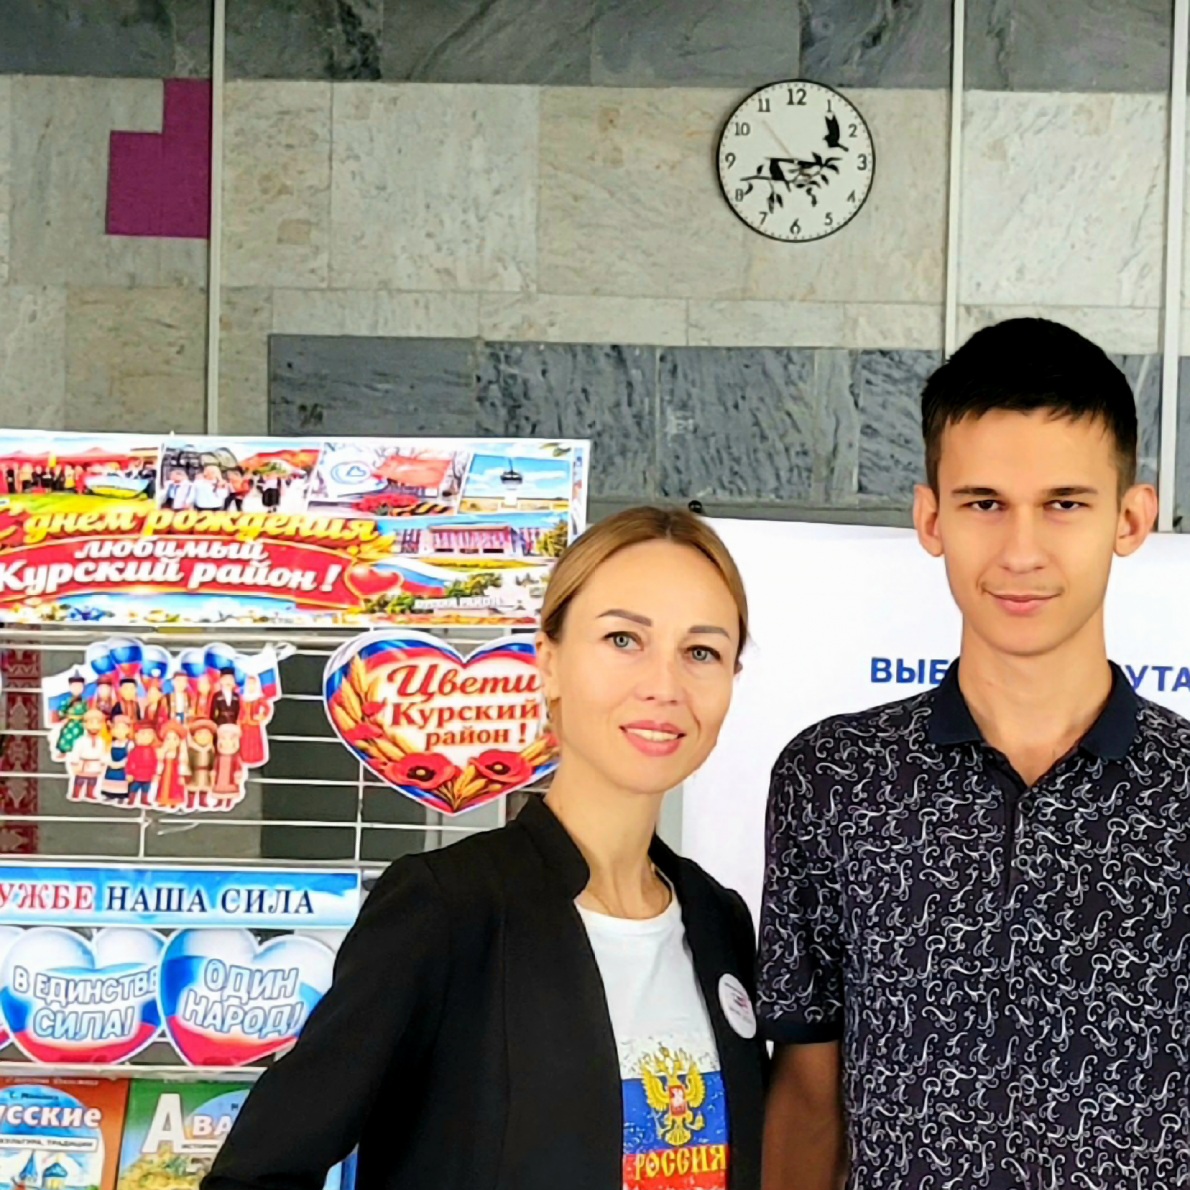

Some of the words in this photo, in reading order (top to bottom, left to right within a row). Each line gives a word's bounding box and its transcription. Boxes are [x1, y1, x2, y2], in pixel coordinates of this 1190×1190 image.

[758, 98, 771, 113] 11
[787, 88, 807, 106] 12
[826, 100, 833, 113] 1
[735, 122, 751, 136] 10
[849, 124, 857, 138] 2
[725, 152, 736, 169] 9
[857, 154, 867, 171] 3
[735, 188, 744, 202] 8
[847, 190, 856, 203] 4
[759, 211, 768, 225] 7
[790, 218, 801, 235] 6
[824, 212, 833, 226] 5
[142, 508, 379, 542] рождения
[74, 538, 269, 560] любимый
[0, 557, 184, 597] Курский
[870, 657, 949, 686] ВЫБ
[387, 663, 540, 703] Цвети
[391, 700, 541, 728] Курский
[106, 886, 208, 914] НАША
[221, 889, 314, 914] СИЛА
[13, 965, 30, 993] В
[204, 958, 298, 1000] ОДИН
[34, 1007, 135, 1040] СИЛА!
[183, 990, 305, 1039] НАРОД!
[634, 1145, 728, 1181] РОССИЯ
